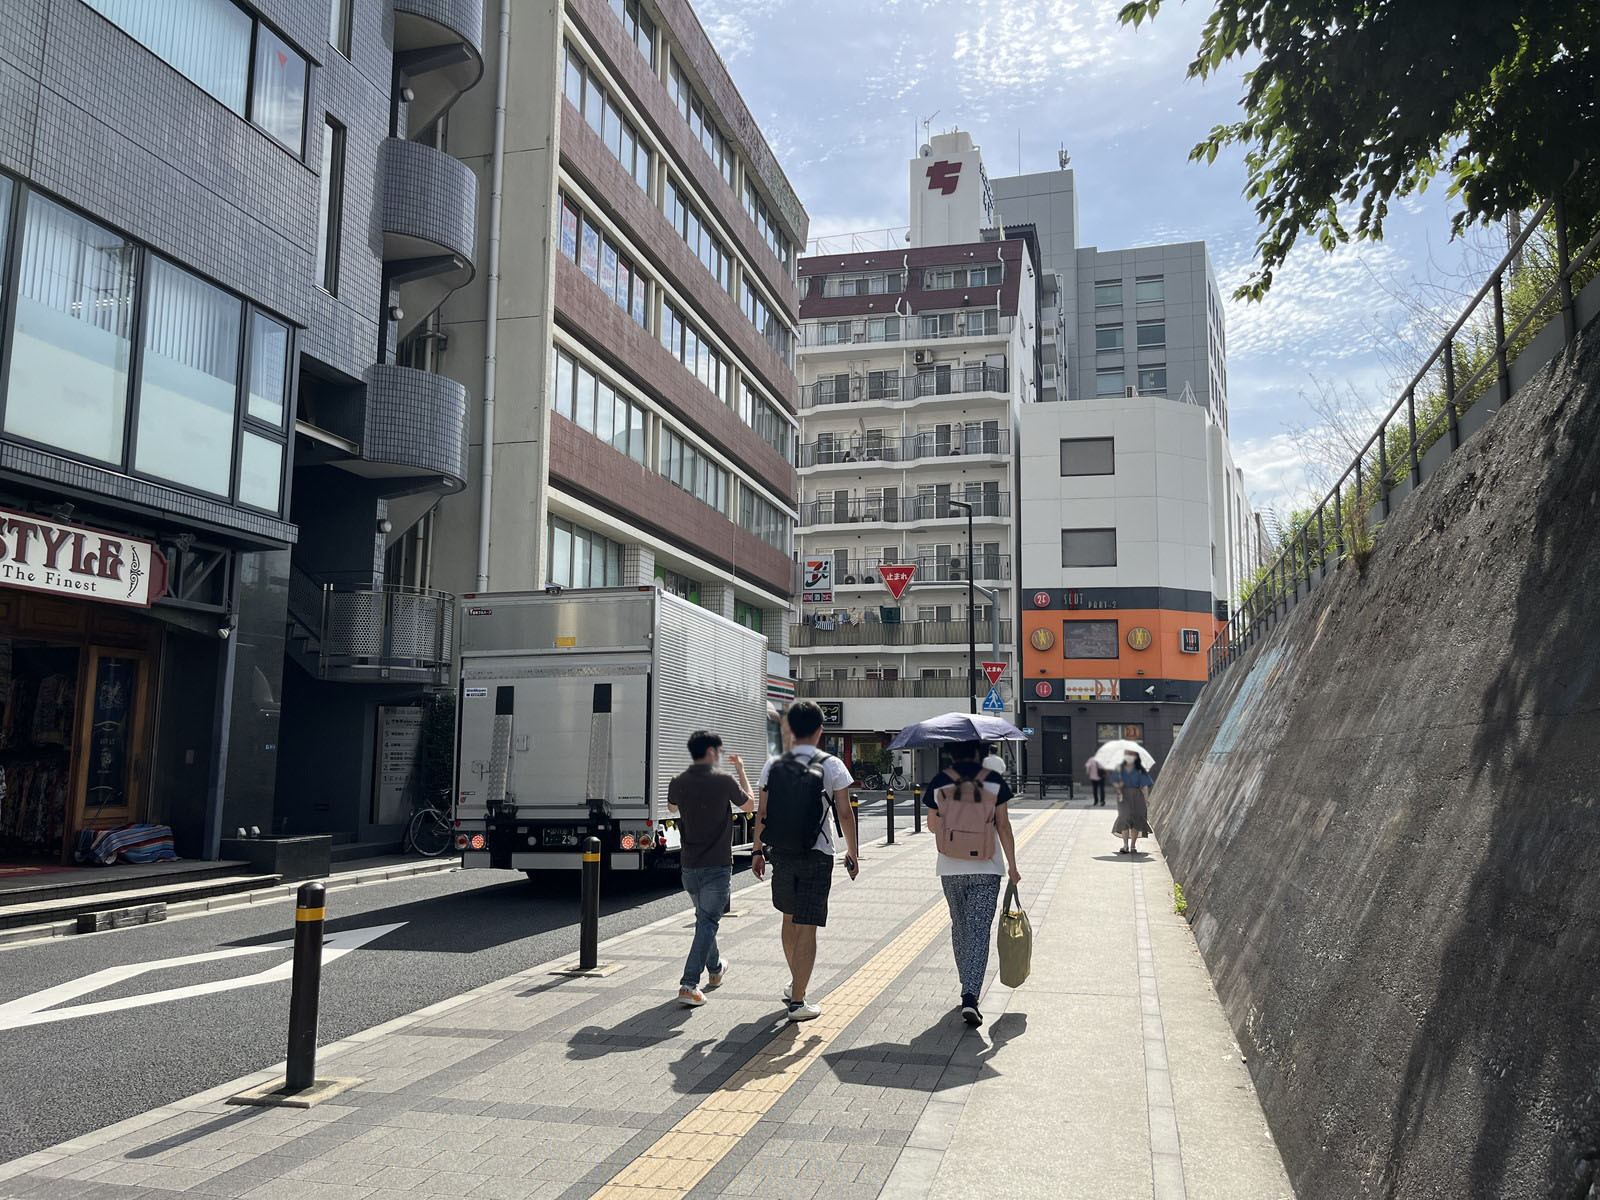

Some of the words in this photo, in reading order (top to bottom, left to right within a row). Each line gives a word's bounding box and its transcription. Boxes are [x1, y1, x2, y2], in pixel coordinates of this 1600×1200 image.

[3, 564, 35, 582] The
[46, 571, 97, 592] Finest
[886, 572, 908, 581] 止まれ
